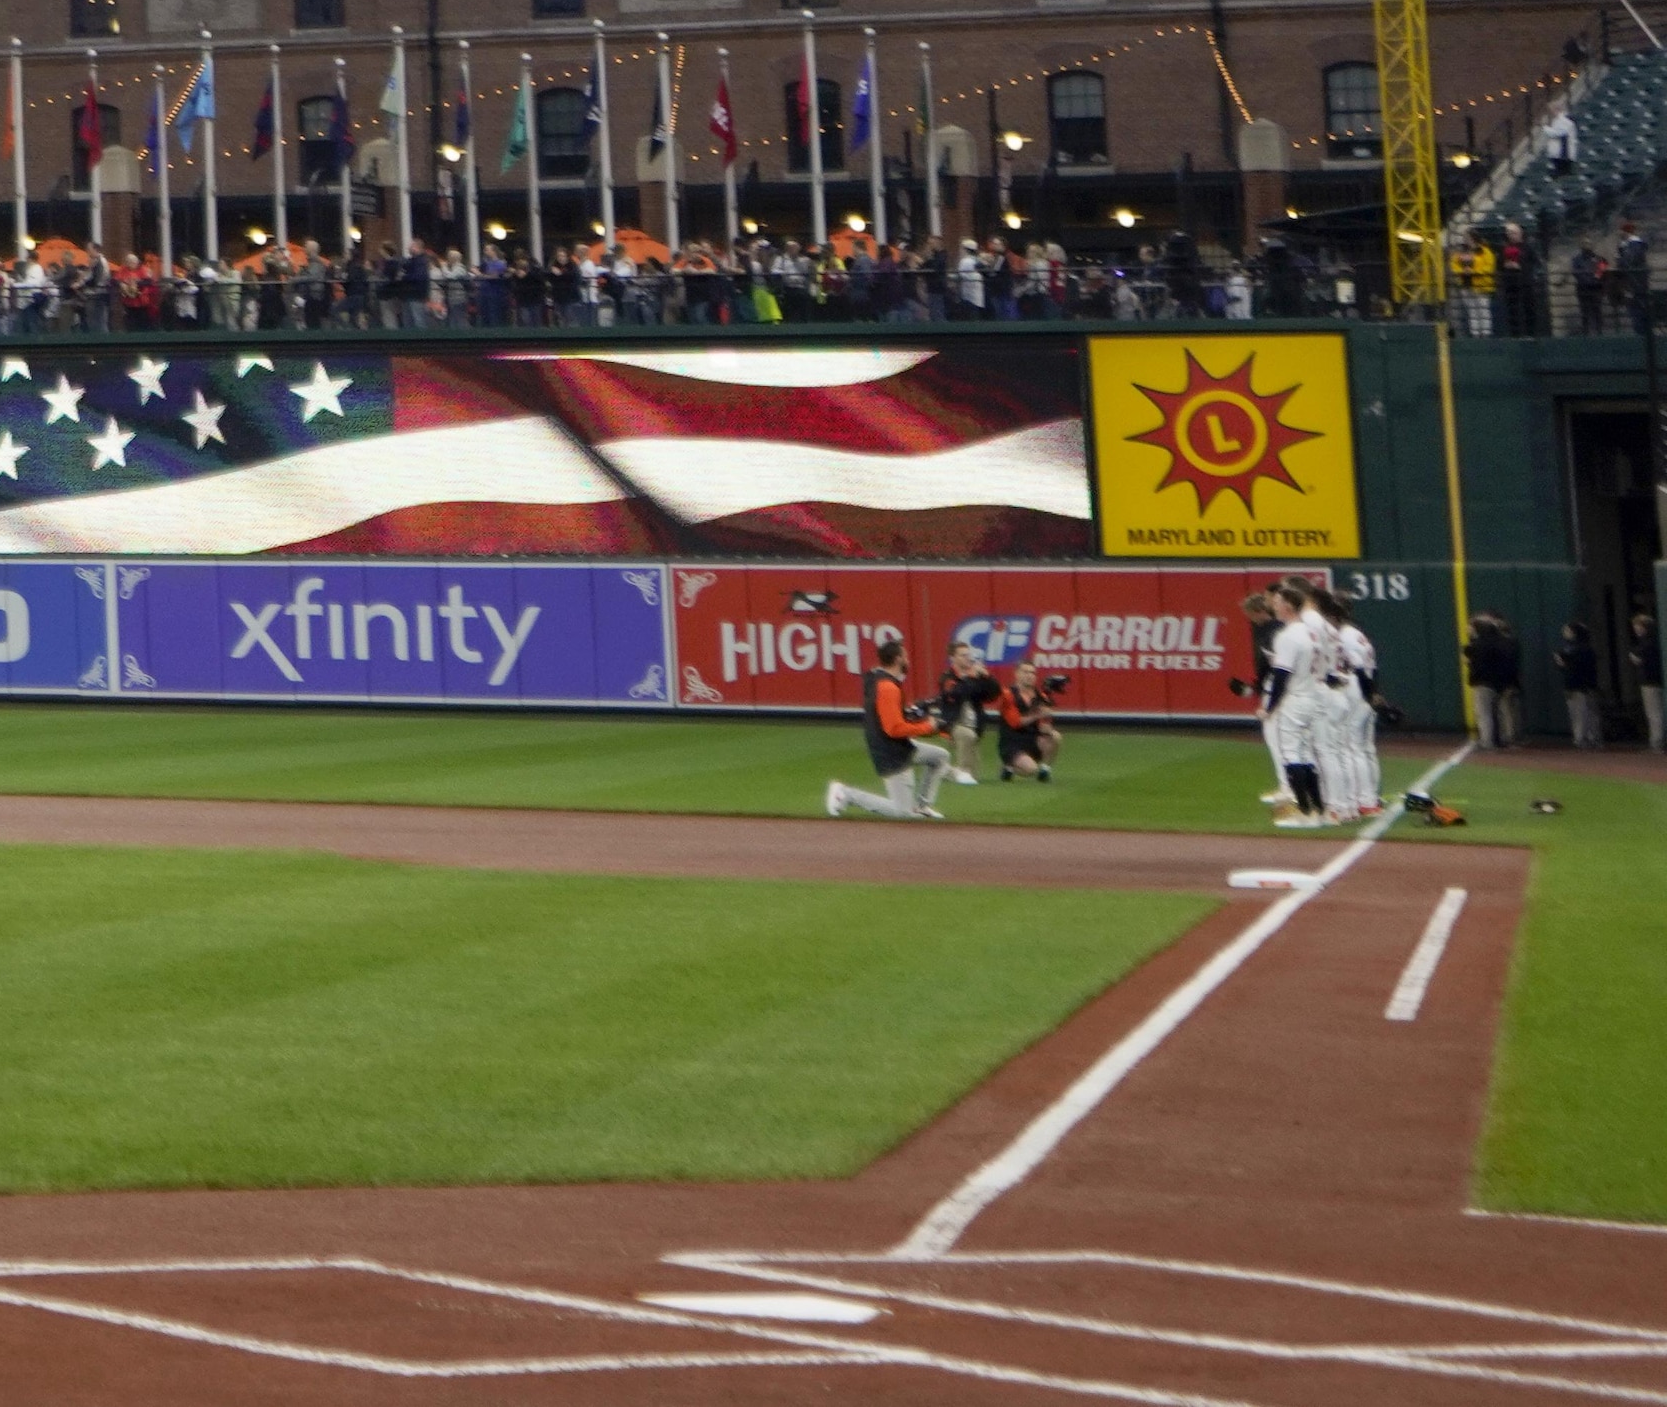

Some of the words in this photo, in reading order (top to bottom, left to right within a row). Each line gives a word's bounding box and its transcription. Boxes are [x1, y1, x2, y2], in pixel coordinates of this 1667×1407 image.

[1205, 414, 1242, 454] L
[1127, 528, 1235, 546] MARYLAND
[1350, 572, 1411, 602] 318
[229, 578, 542, 686] xfinity
[1035, 615, 1225, 652] CARROLL
[1033, 653, 1131, 670] MOTOR
[1137, 654, 1225, 671] FUELS
